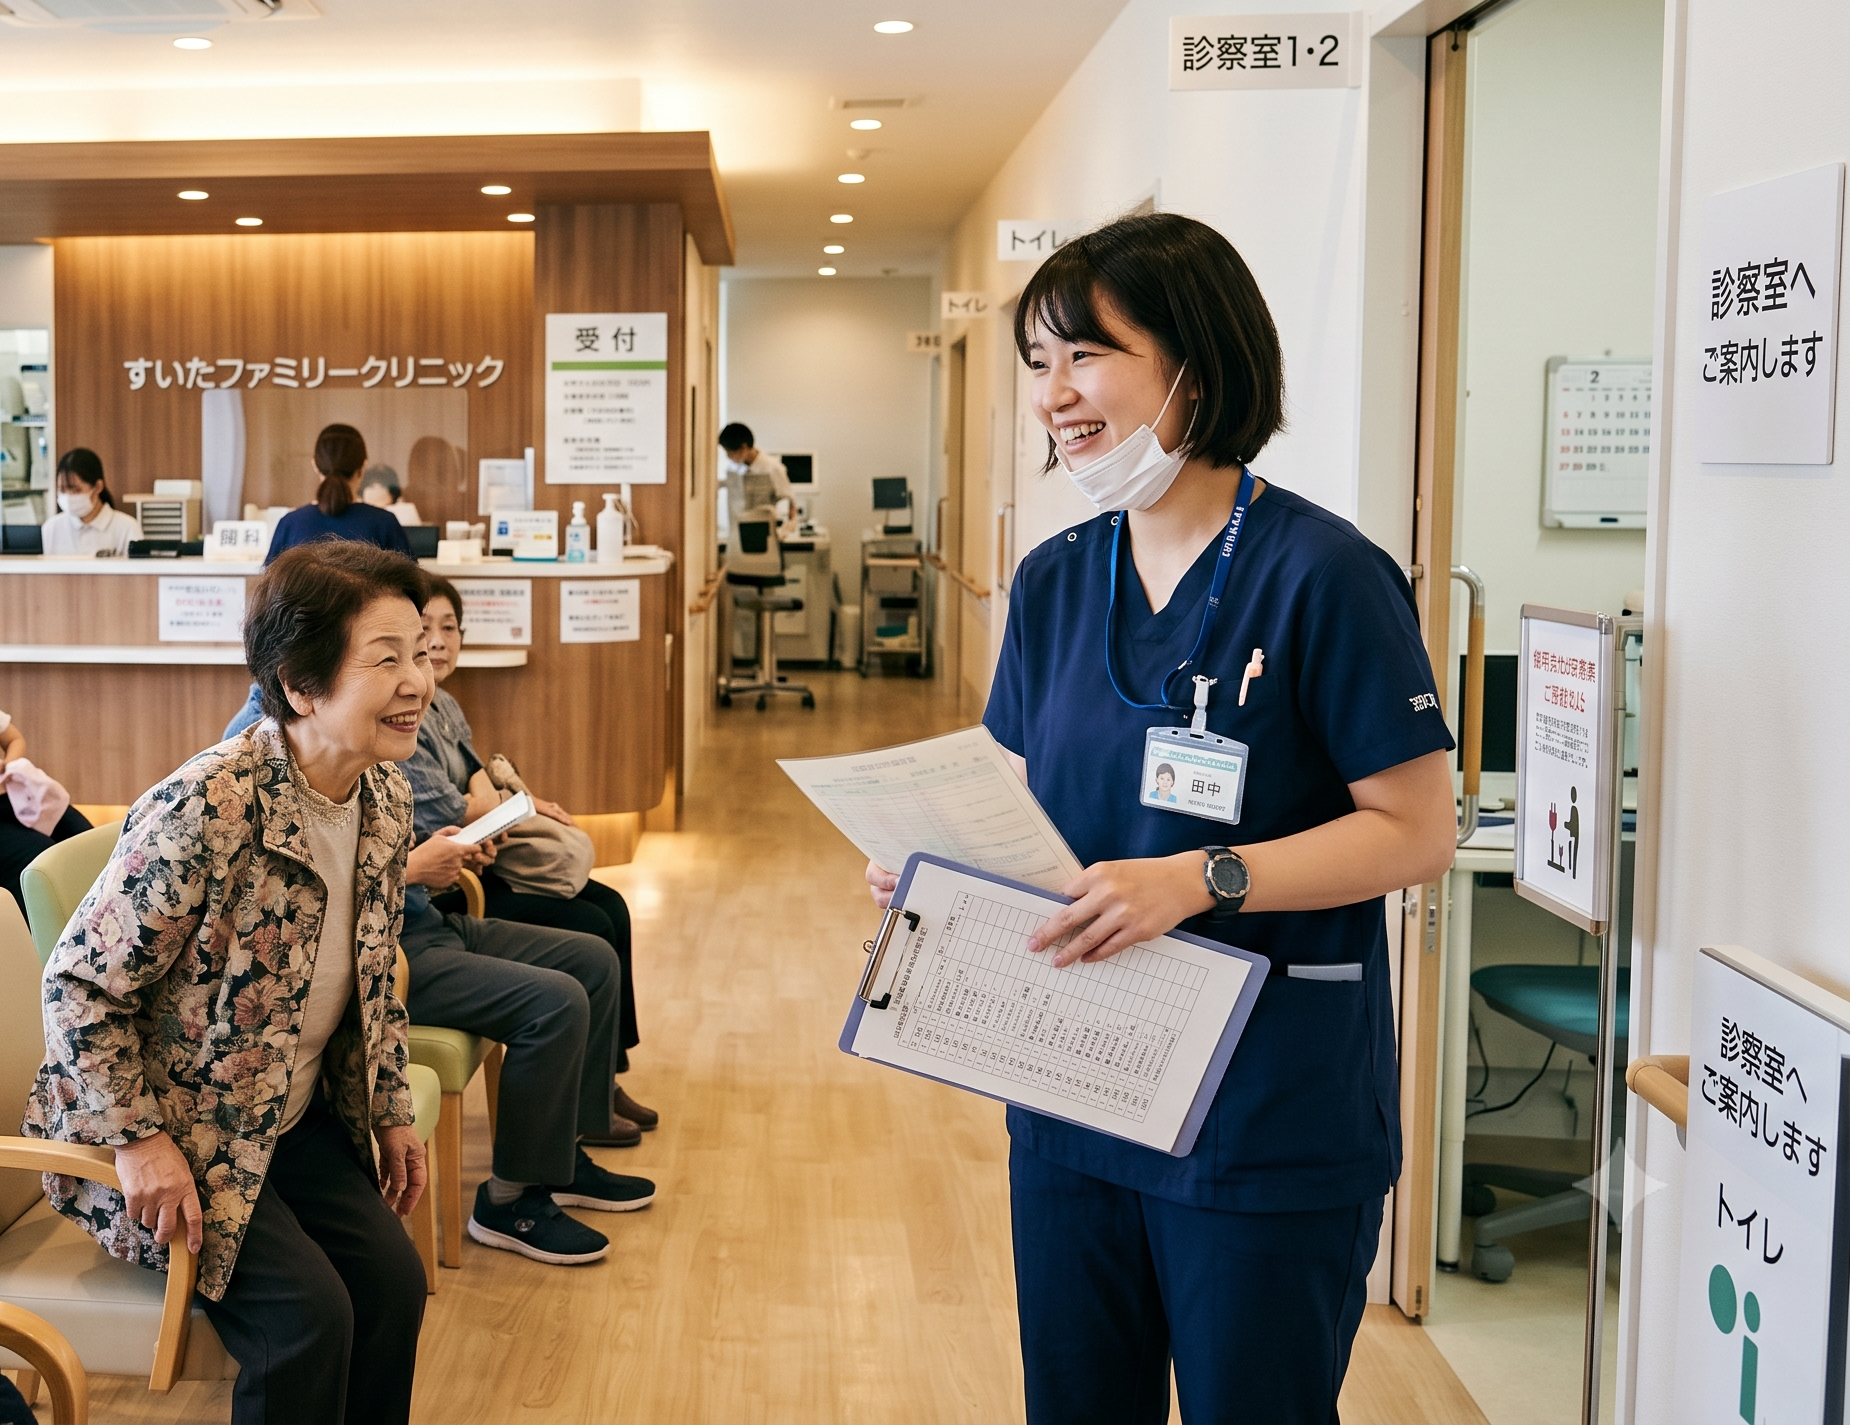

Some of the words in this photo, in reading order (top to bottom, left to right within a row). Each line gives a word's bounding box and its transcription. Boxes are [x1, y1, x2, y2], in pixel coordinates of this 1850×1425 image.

[1183, 34, 1339, 71] 診察室1・2
[948, 298, 988, 313] トイレ
[1711, 257, 1816, 321] 診察室へ
[575, 326, 637, 352] 受付
[123, 355, 504, 390] すいたファミリークリニック
[1702, 330, 1824, 386] ご案内します
[1590, 370, 1599, 384] 2
[1616, 411, 1625, 419] 10
[1616, 428, 1625, 436] 17
[1191, 779, 1221, 797] 田中
[1720, 1016, 1807, 1104] 診察室へ
[1701, 1064, 1827, 1177] ご案内します
[1718, 1182, 1784, 1265] トイレ
